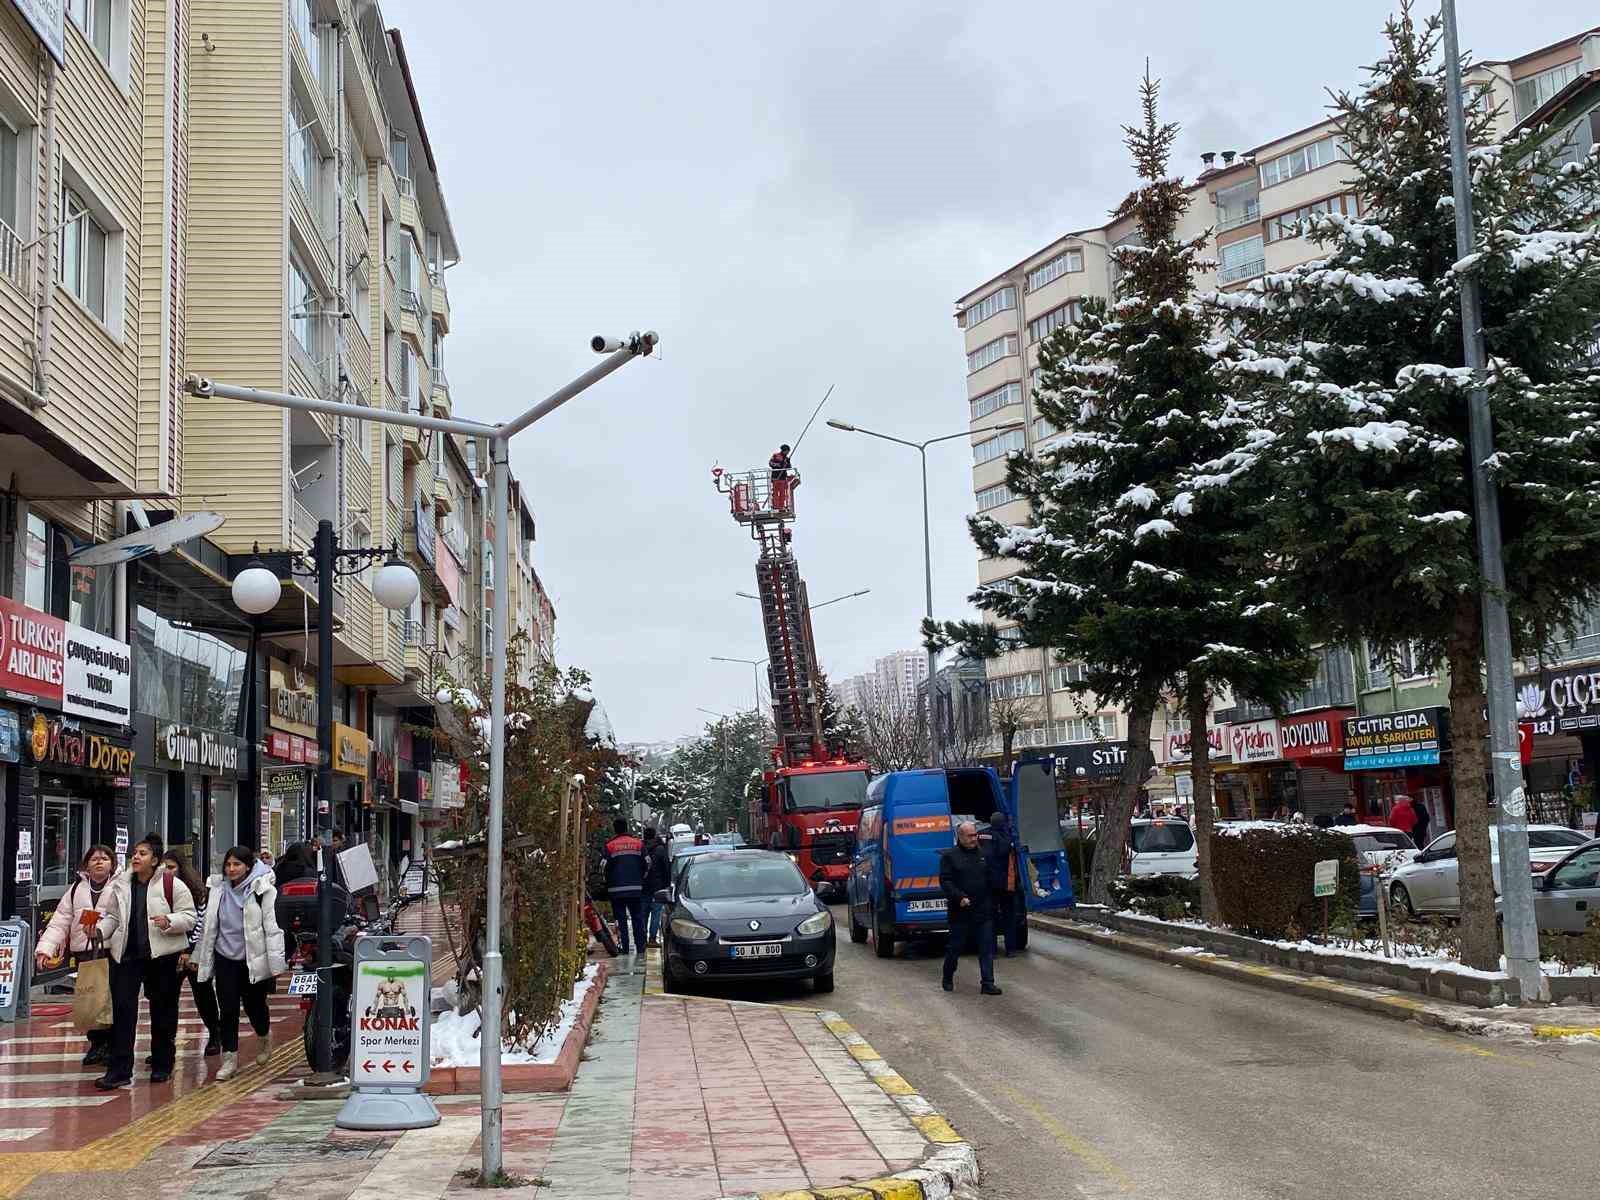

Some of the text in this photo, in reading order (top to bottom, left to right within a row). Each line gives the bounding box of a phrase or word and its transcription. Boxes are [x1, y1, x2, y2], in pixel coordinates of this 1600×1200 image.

[9, 614, 63, 656] TURKISH
[8, 646, 63, 686] AIRLINES
[1281, 720, 1329, 748] DOYDUM
[1357, 713, 1428, 735] ÇITIR GIDA
[49, 719, 85, 766] Kral
[89, 735, 135, 775] Döner
[167, 724, 198, 770] Giyim
[201, 732, 237, 776] Dünyası
[1346, 735, 1373, 749] TAVUK
[1375, 733, 1381, 744] &
[272, 773, 300, 784] OKUL
[751, 945, 760, 955] AV
[360, 1018, 420, 1031] KONAK
[360, 1035, 420, 1048] Spor Merkezi
